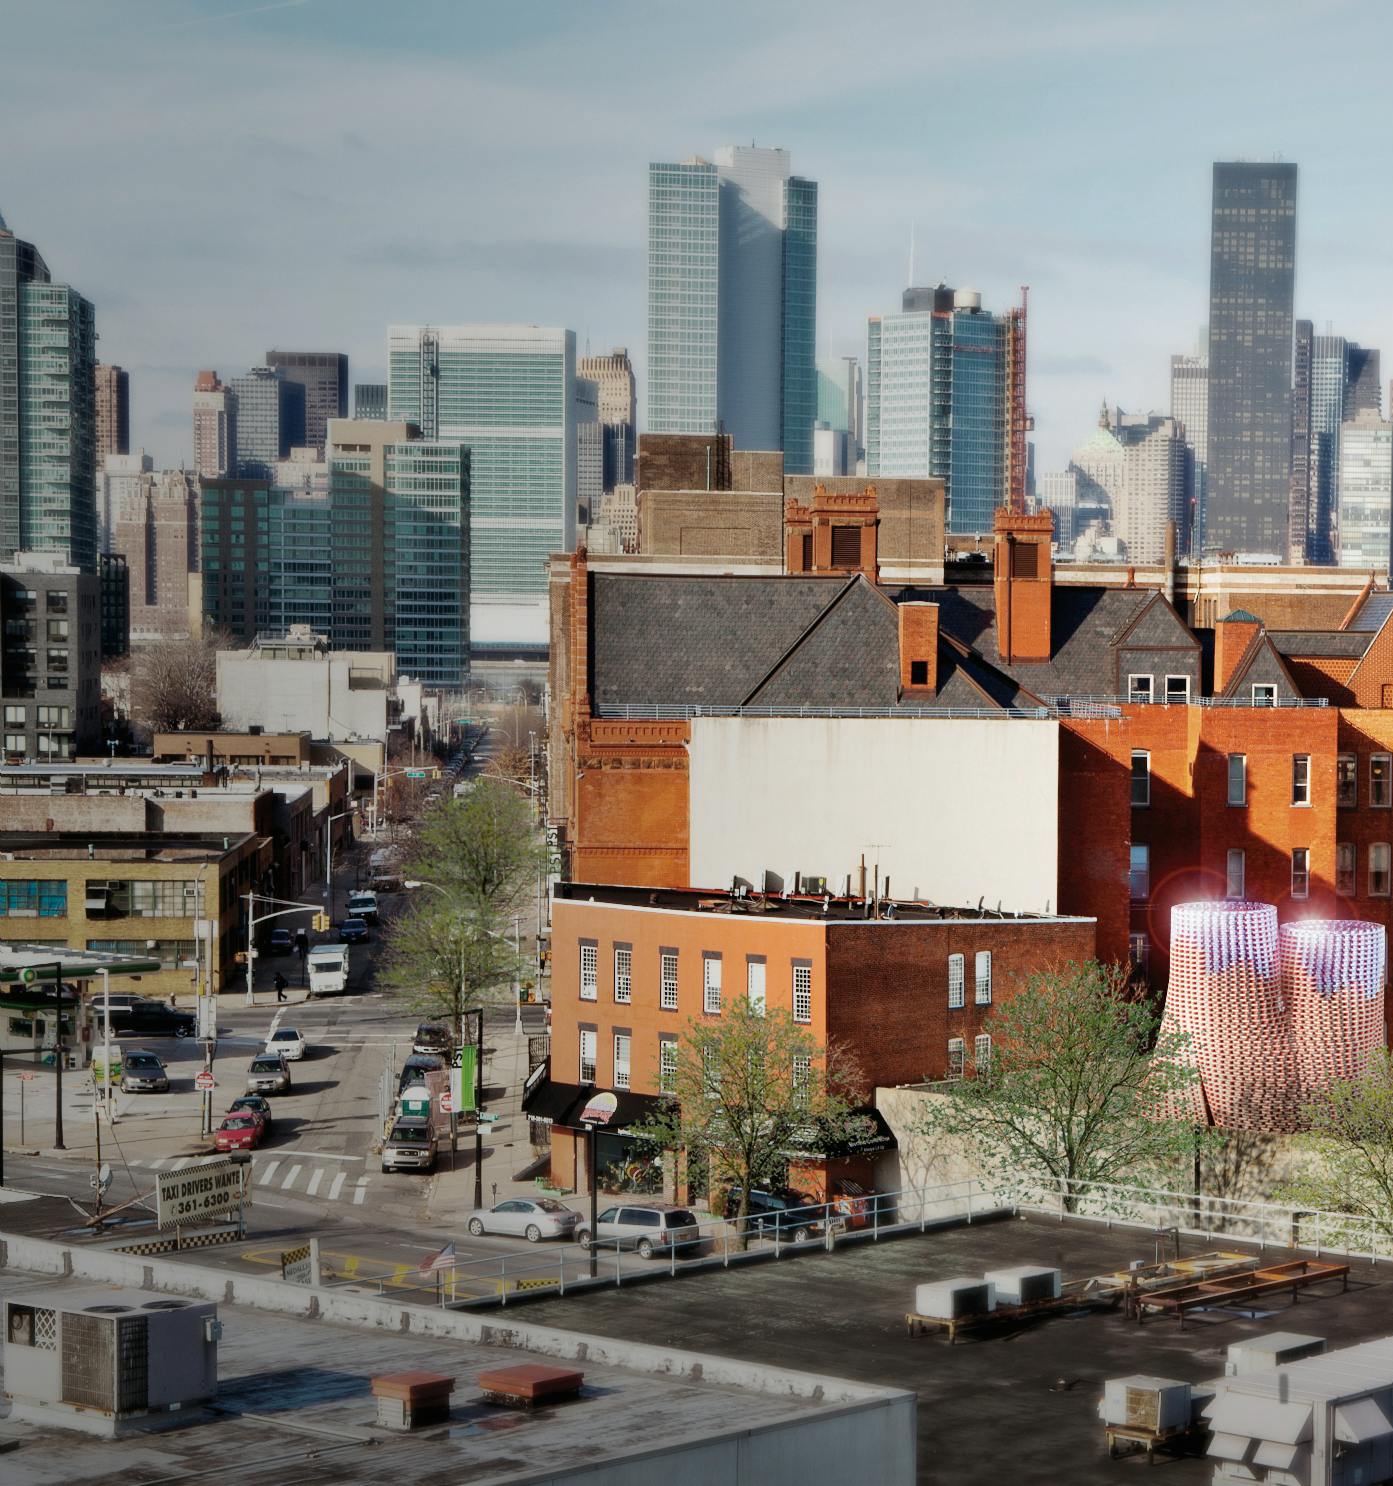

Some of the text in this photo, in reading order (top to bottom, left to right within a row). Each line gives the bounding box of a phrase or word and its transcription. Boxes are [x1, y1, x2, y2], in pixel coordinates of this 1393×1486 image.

[162, 1185, 179, 1202] TAXI
[181, 1176, 213, 1197] DRIVERS
[178, 1192, 229, 1214] 361-6300
